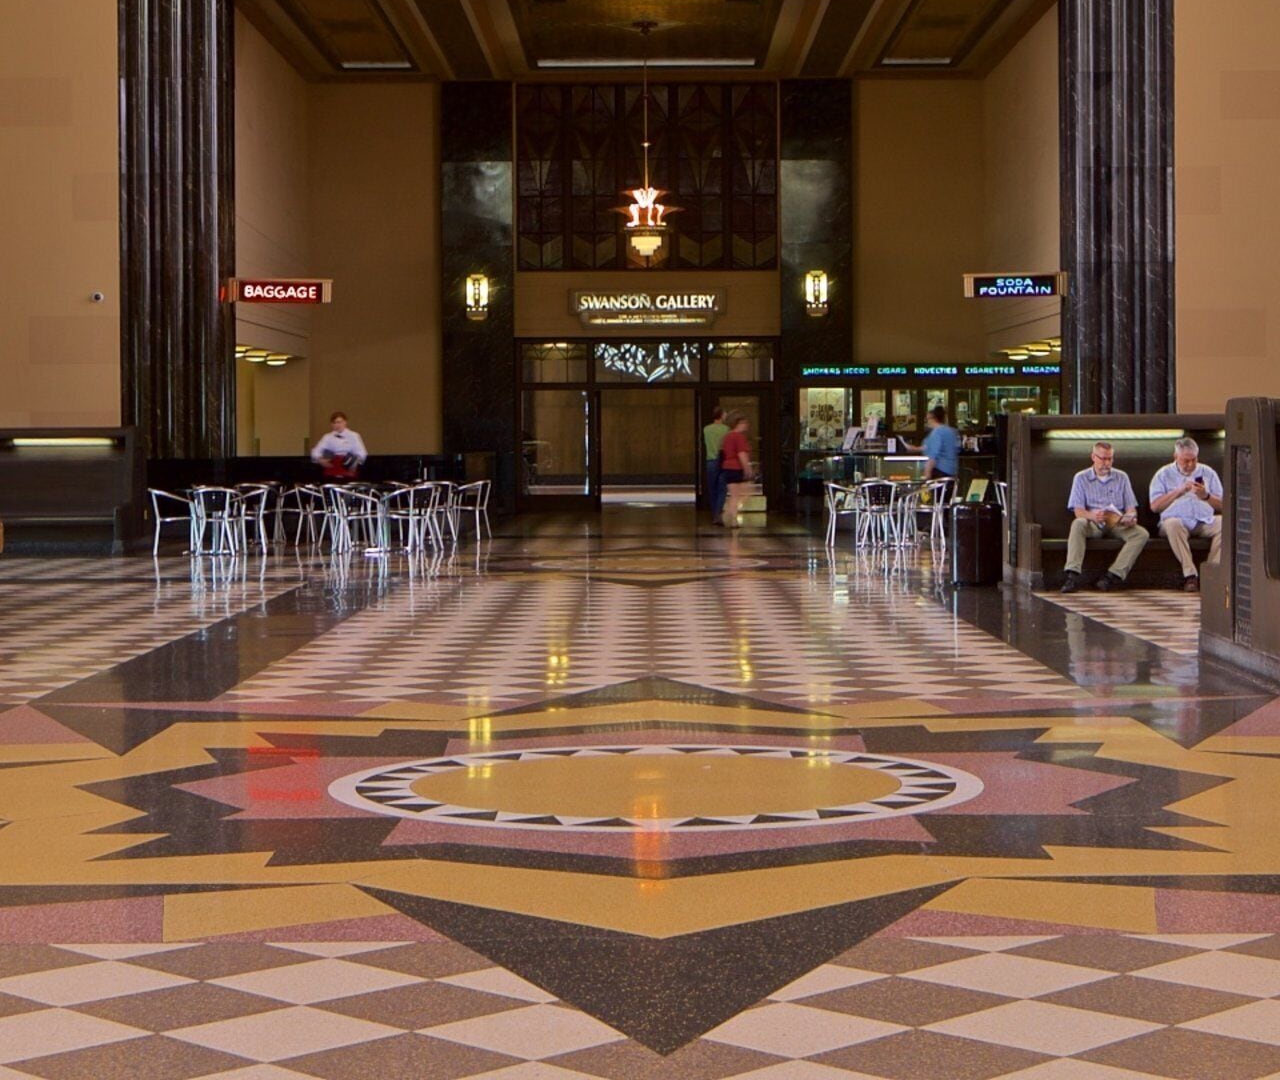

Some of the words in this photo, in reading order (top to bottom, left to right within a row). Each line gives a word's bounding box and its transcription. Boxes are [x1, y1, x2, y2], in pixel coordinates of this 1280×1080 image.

[996, 277, 1034, 287] SODA
[243, 284, 317, 299] BAGGAGE
[979, 285, 1053, 296] FOUNTAIN
[580, 294, 652, 310] SWANSON
[655, 293, 716, 310] GALLERY
[877, 367, 907, 375] CIGARS
[914, 366, 958, 375] NOVELTIES
[964, 366, 1016, 375] CIGARETTES
[1022, 365, 1060, 374] MAGAZIN
